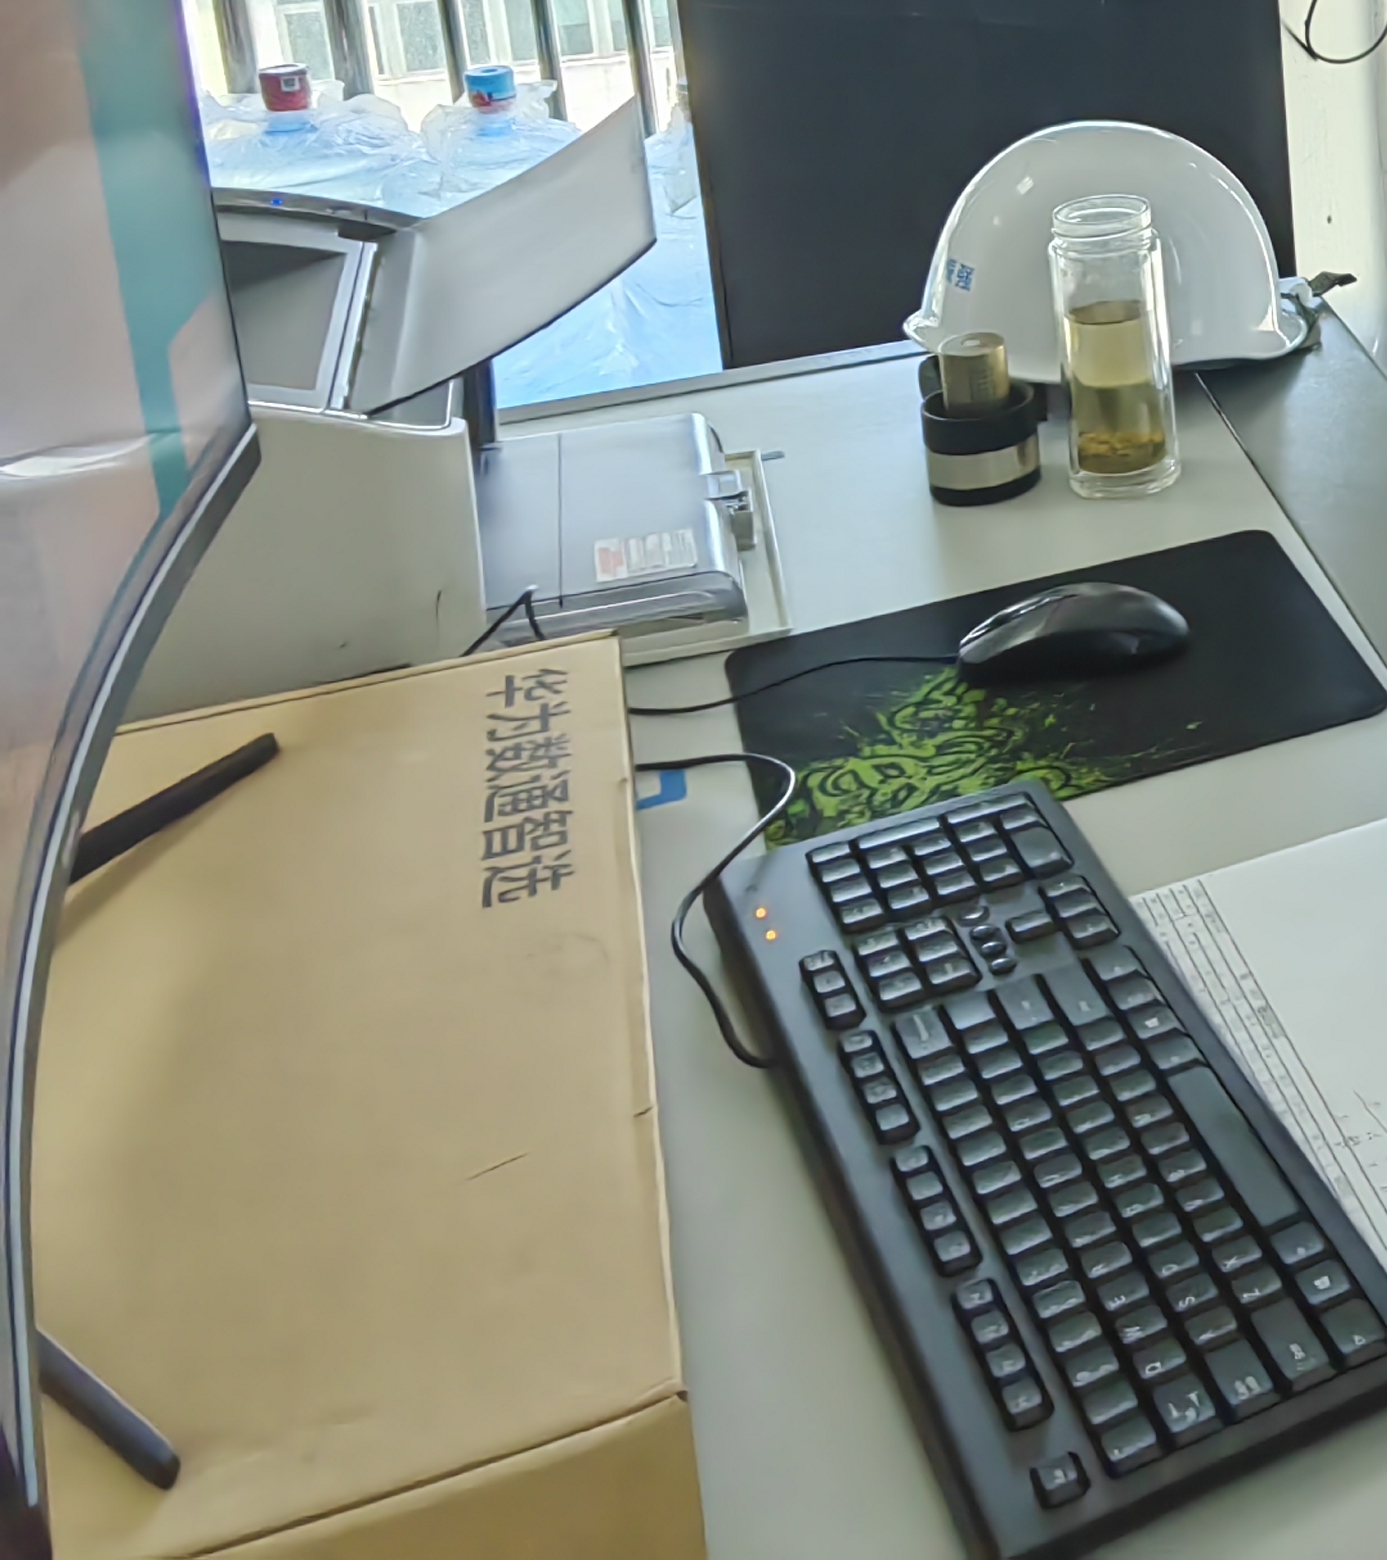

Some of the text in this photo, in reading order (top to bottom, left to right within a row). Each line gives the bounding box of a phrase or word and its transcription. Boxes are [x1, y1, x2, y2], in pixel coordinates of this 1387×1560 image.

[481, 668, 575, 909] 华为数通智选
